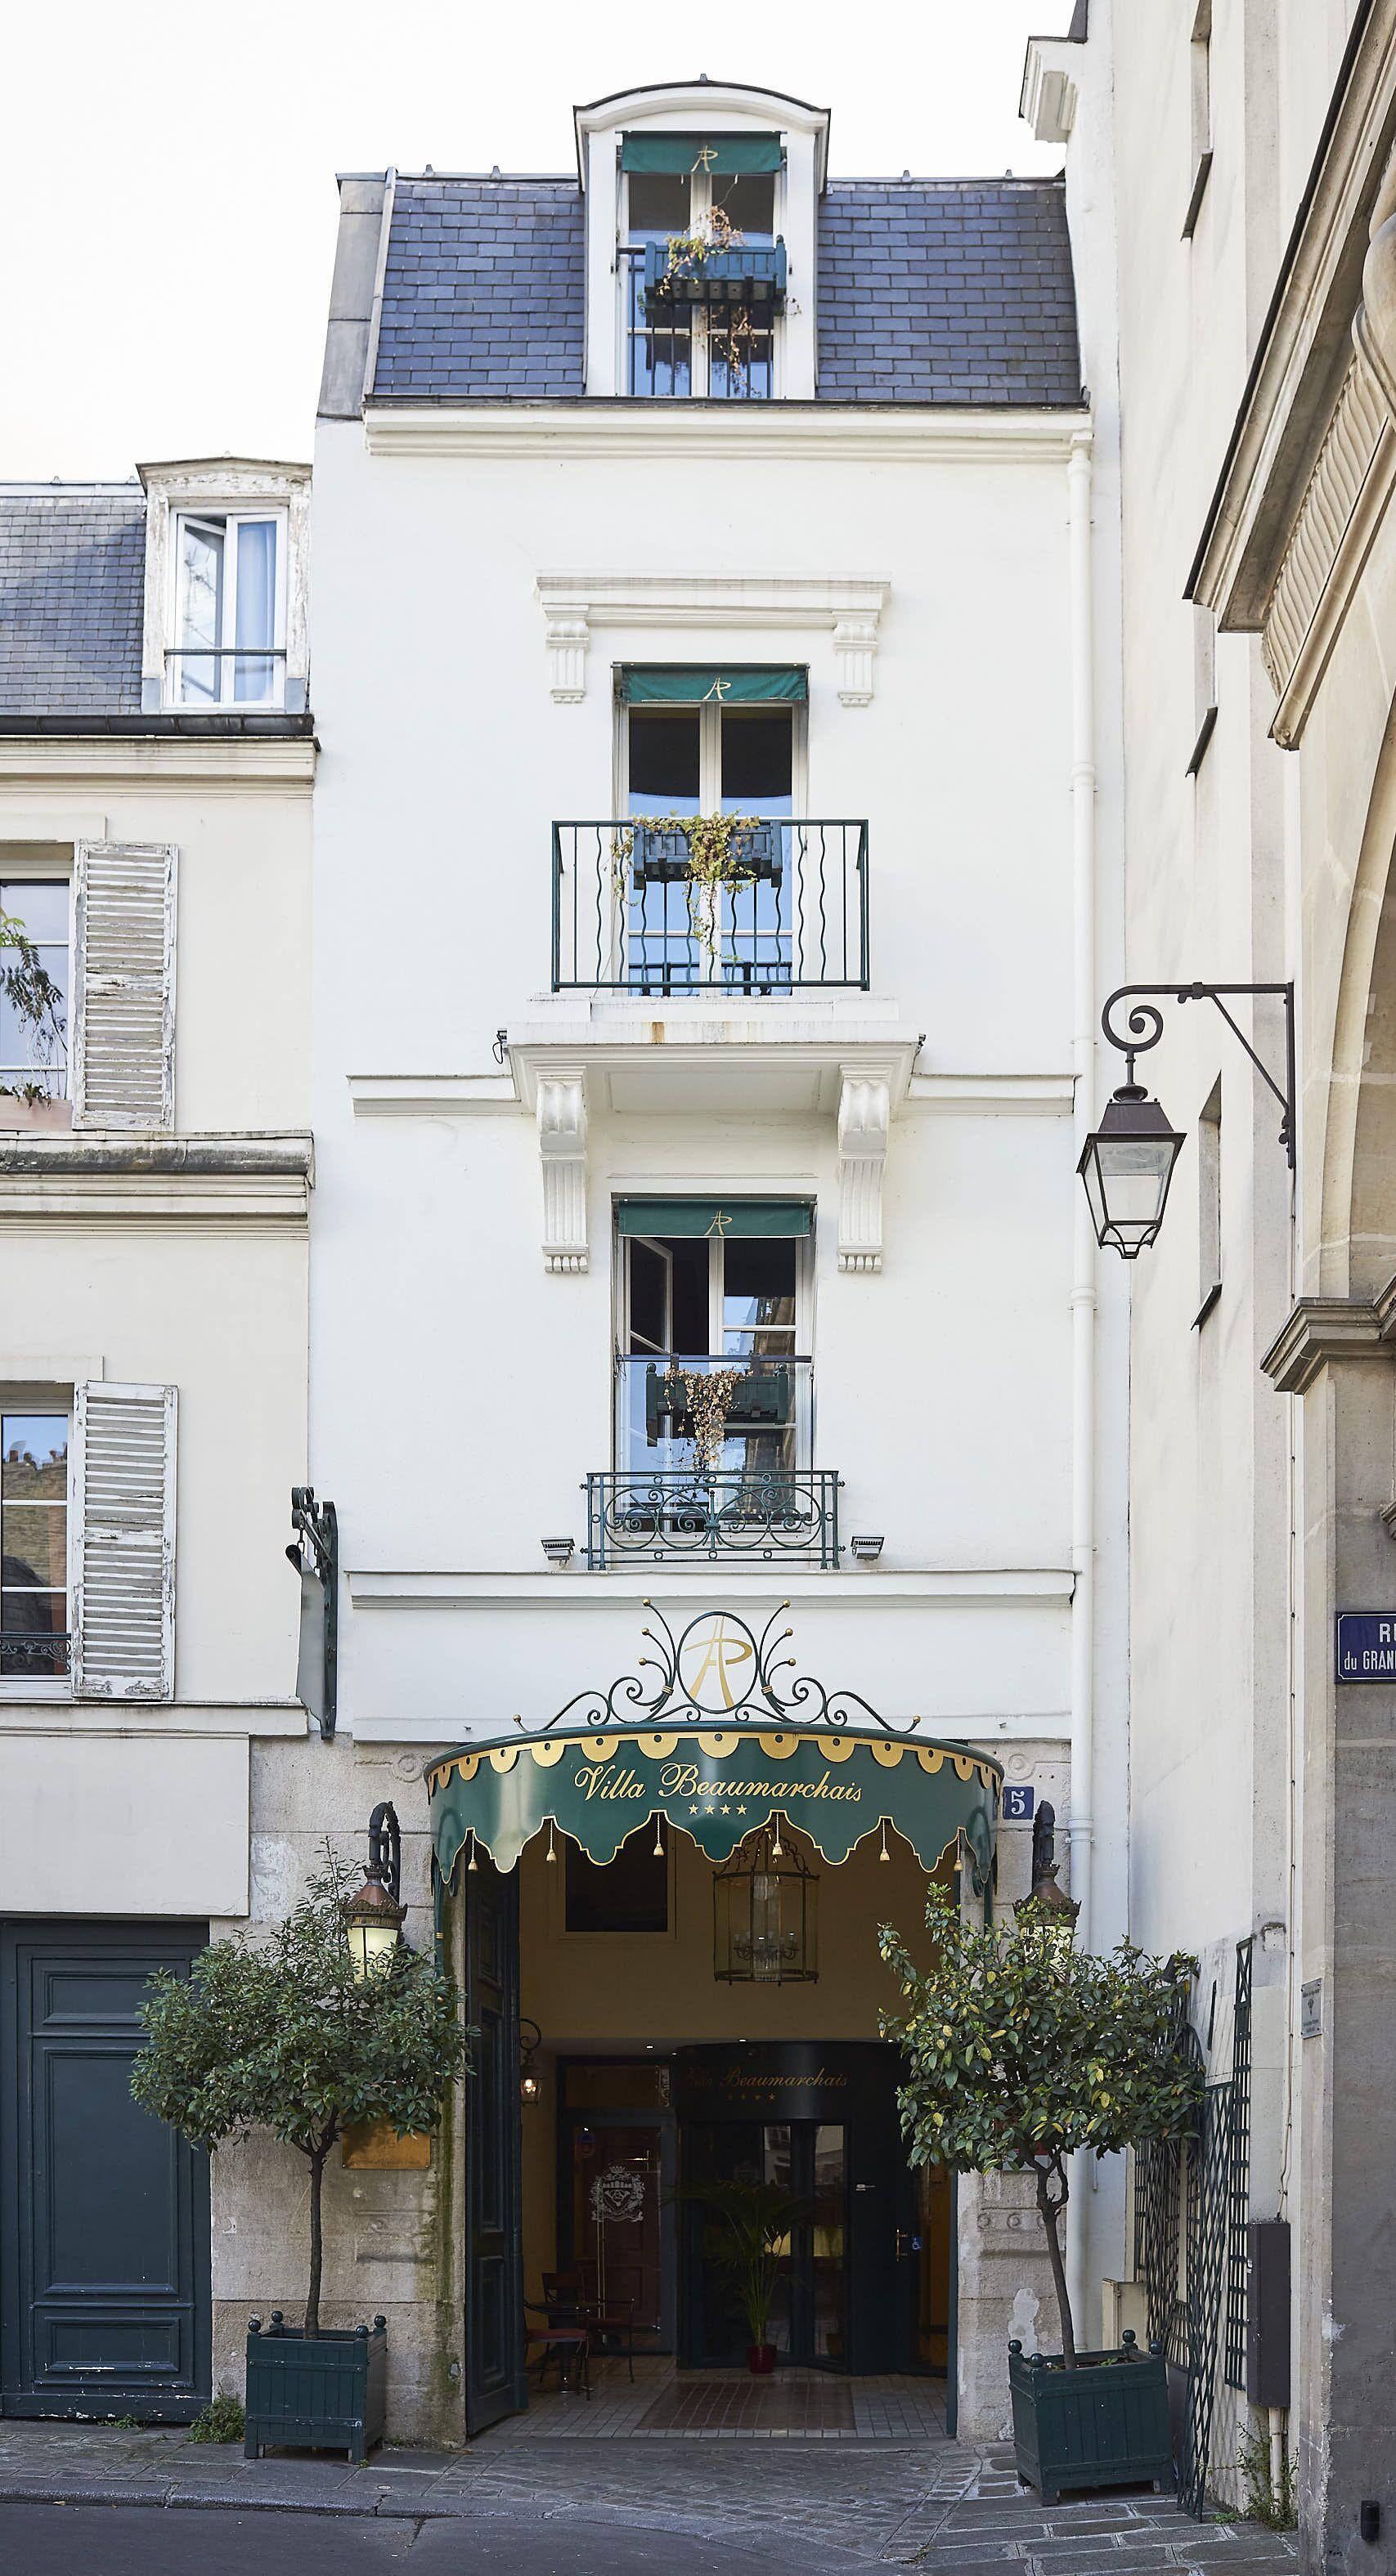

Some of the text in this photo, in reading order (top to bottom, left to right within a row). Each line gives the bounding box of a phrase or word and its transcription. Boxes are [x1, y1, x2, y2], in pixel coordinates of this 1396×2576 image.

[1380, 1623, 1396, 1643] R
[1344, 1650, 1396, 1670] du GRAN
[574, 1763, 862, 1802] Villa Beaumarchais
[1011, 1790, 1026, 1815] 5
[720, 2066, 848, 2087] Beaumarchais
